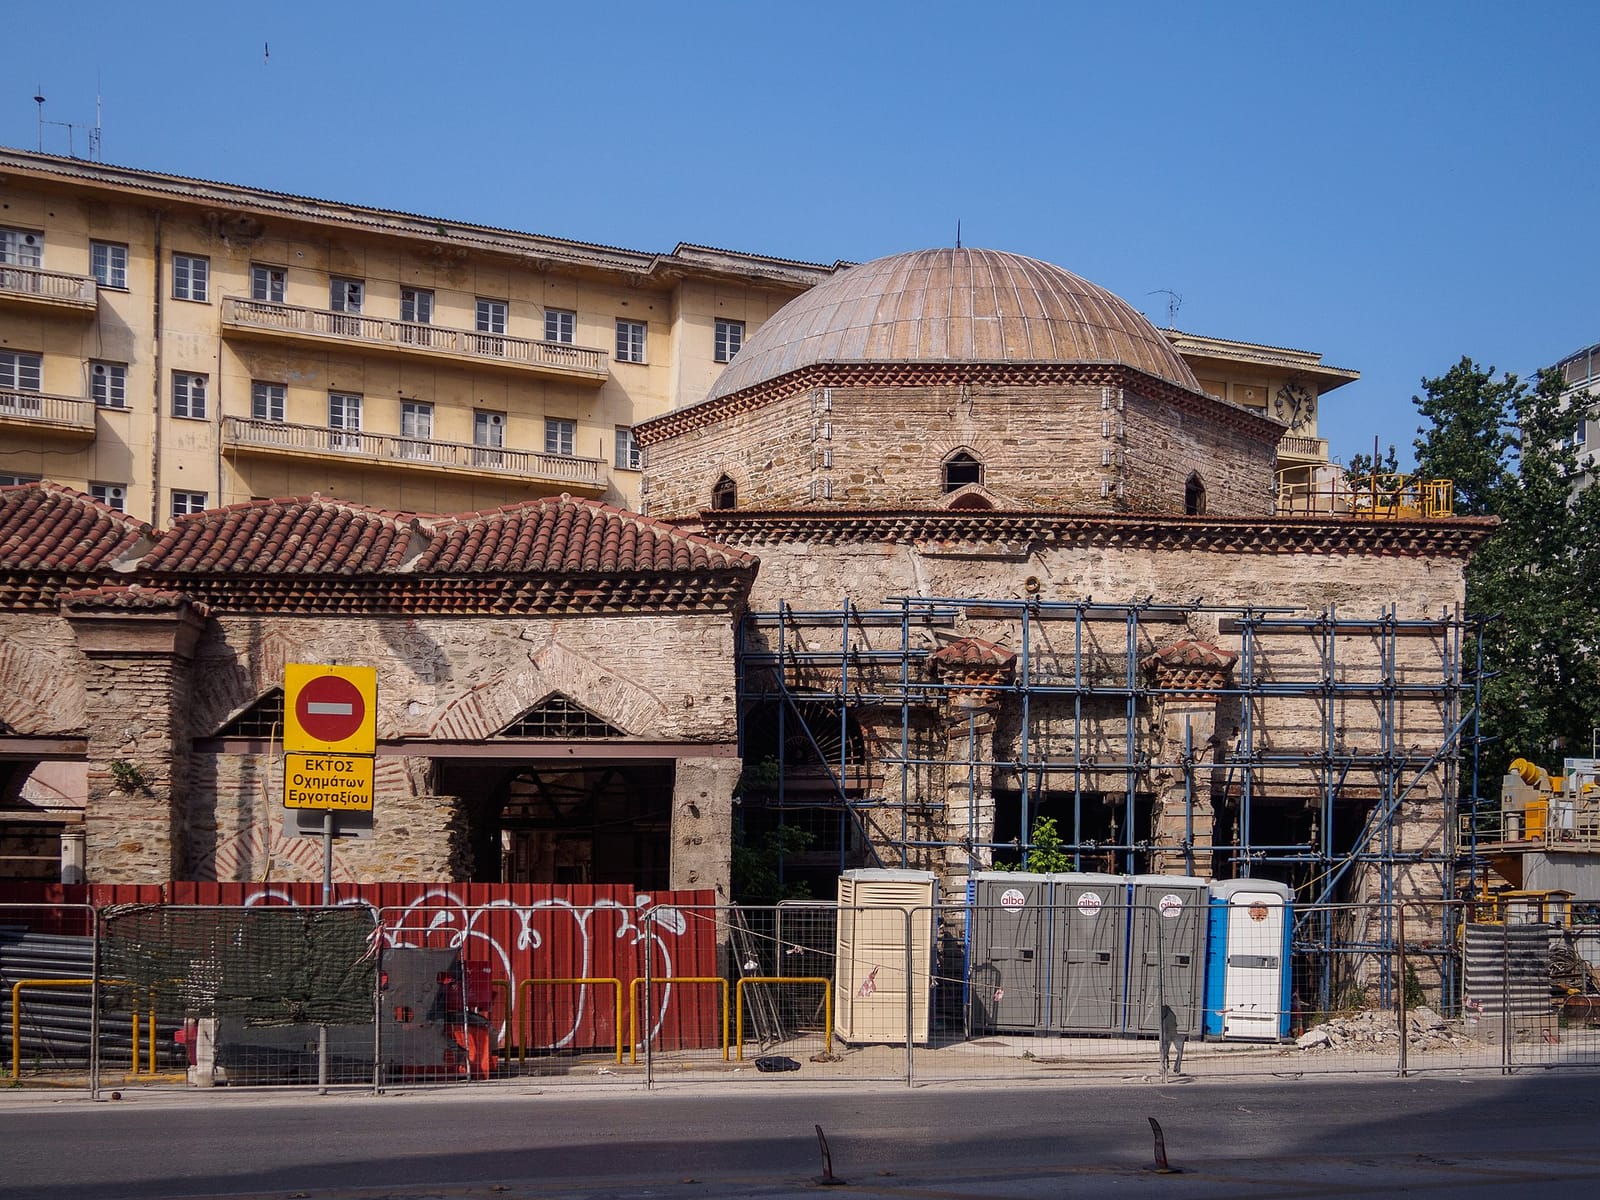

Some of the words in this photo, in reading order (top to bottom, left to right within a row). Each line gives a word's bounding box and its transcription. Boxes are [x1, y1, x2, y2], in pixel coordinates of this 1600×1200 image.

[305, 759, 354, 772] ΕΚΤΟΣ
[293, 774, 365, 789] Οχημάτων
[289, 790, 368, 805] Εργοταξίου
[1002, 896, 1024, 904] alba
